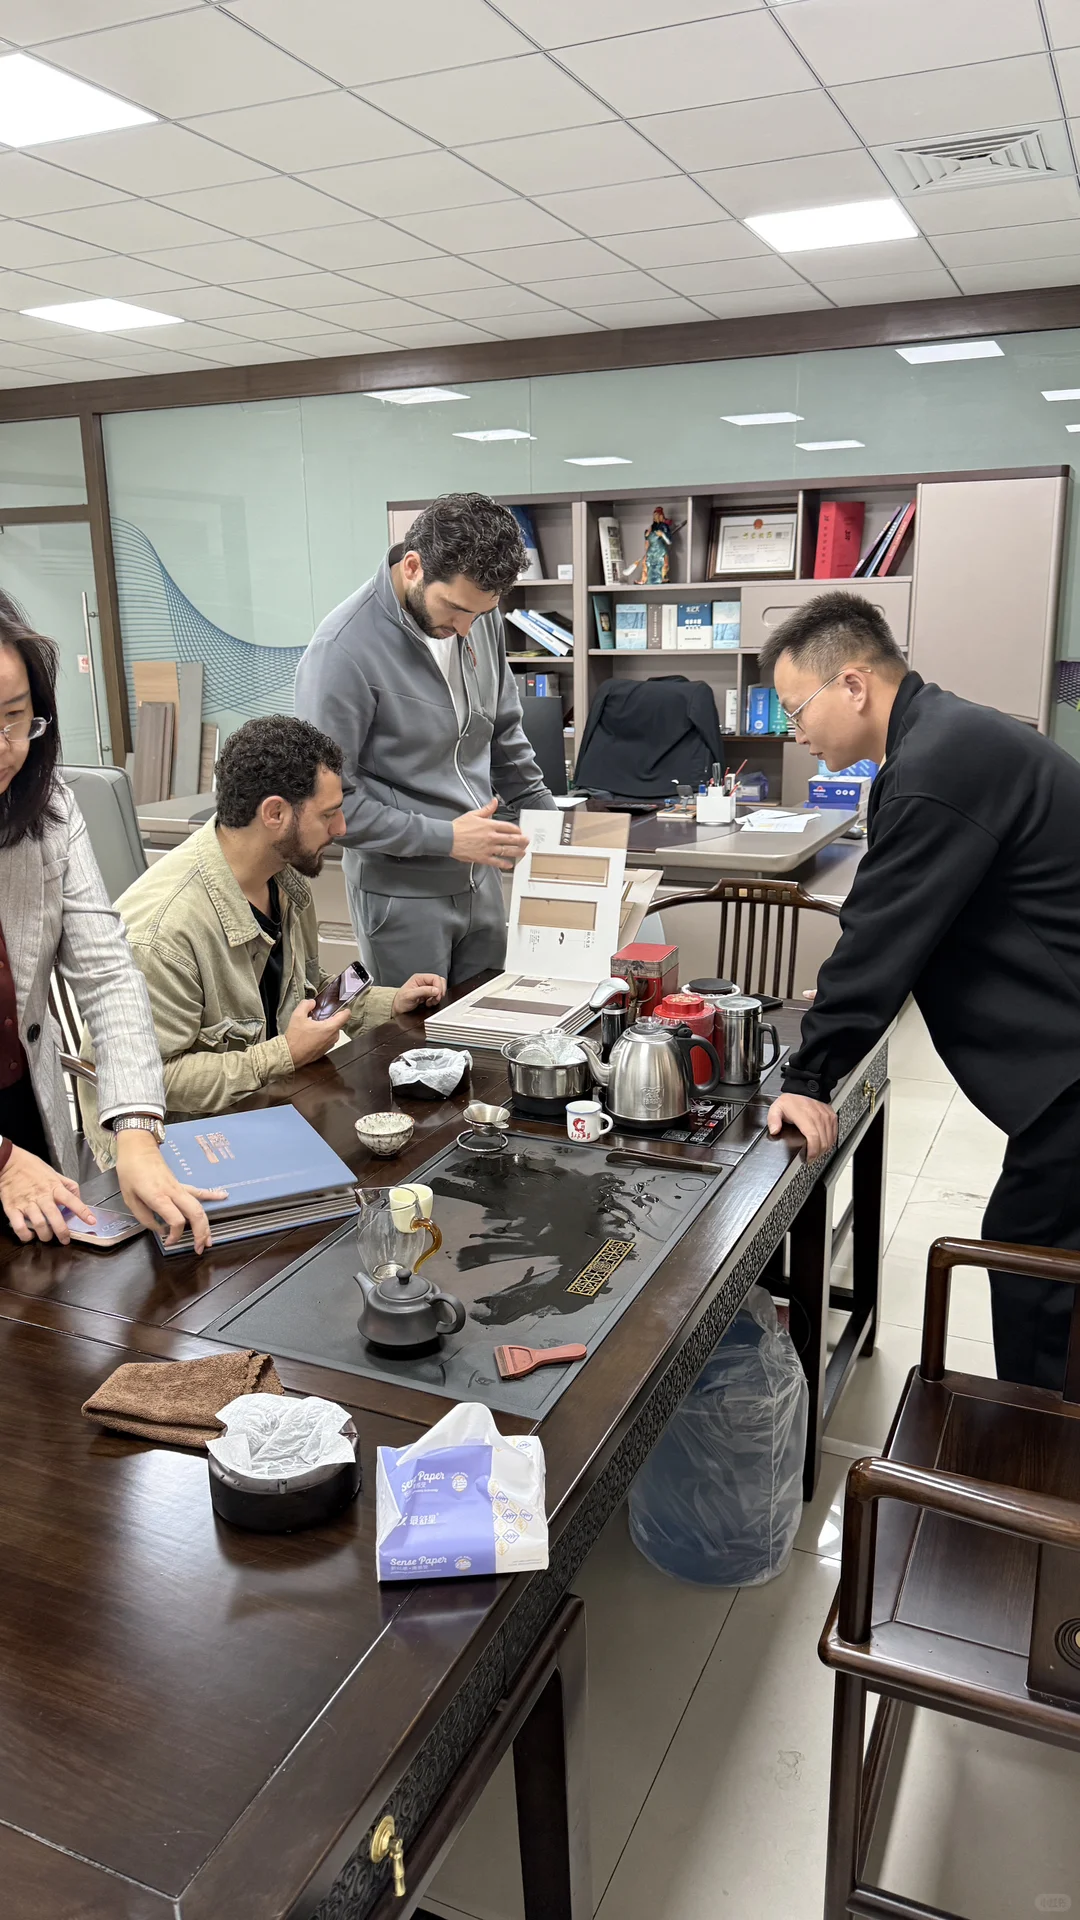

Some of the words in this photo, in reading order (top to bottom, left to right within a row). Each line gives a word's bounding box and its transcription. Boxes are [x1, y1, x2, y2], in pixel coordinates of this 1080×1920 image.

[418, 1470, 445, 1483] Paper
[390, 1557, 417, 1567] Sense
[418, 1555, 447, 1567] Paper
